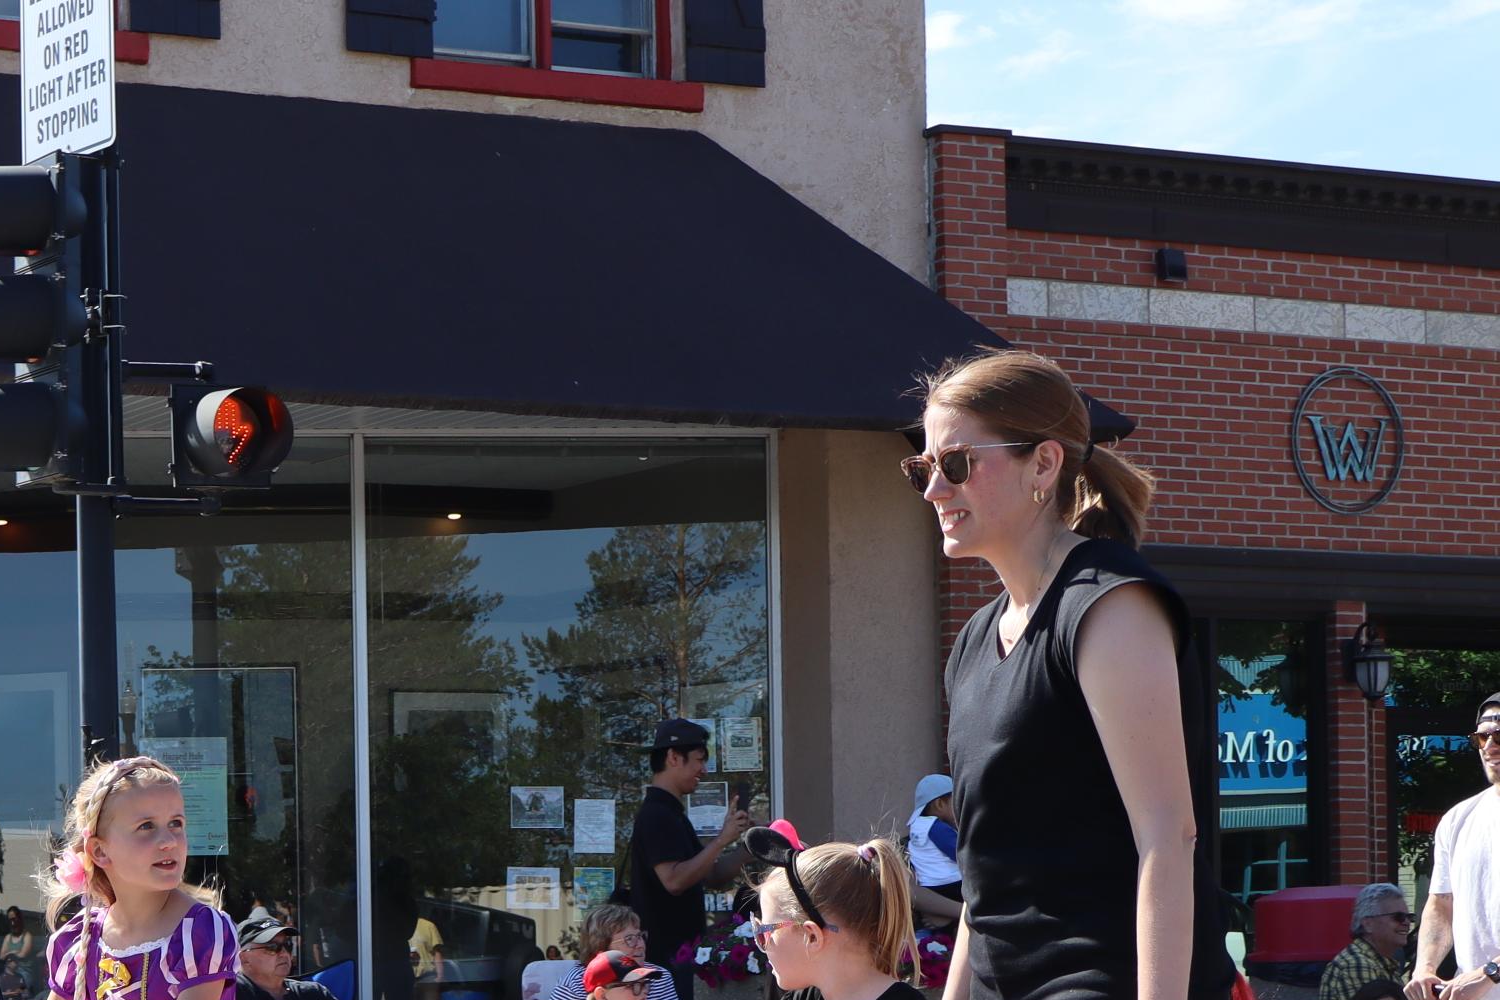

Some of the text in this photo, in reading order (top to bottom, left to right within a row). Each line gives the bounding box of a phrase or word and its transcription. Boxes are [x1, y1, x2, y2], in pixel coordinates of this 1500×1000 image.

[37, 0, 94, 38] ALLOWED
[43, 29, 89, 70] ON RED
[29, 58, 107, 112] LIGHT AFTER
[37, 97, 99, 144] STOPPING
